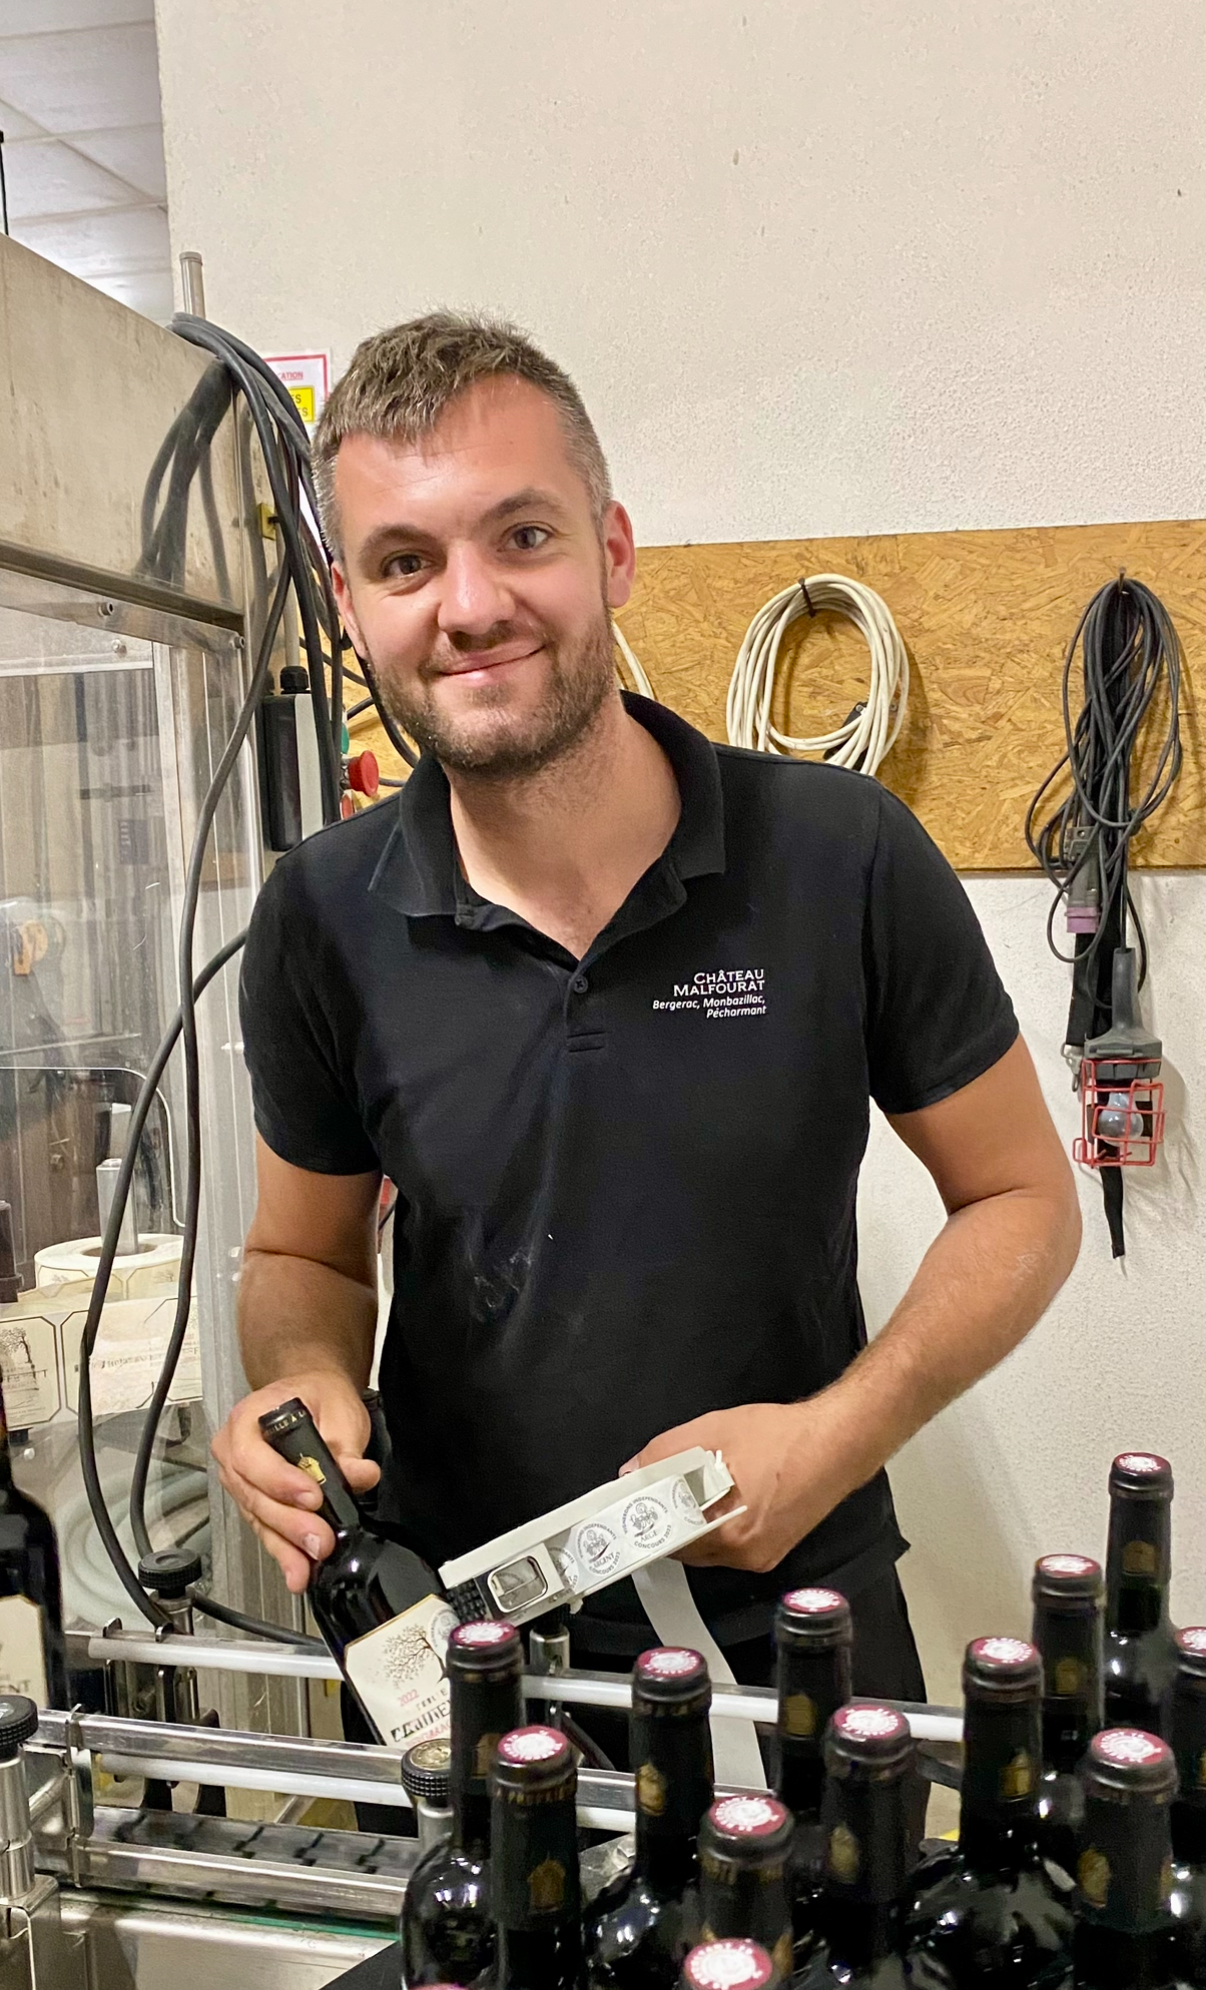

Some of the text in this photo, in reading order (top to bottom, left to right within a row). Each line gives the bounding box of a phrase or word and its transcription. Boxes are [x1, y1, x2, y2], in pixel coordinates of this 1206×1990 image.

[694, 969, 764, 984] CHÂTEAU
[674, 980, 765, 996] MALFOURAT
[653, 995, 765, 1011] Bergerac, Monbazillac,
[707, 1006, 766, 1018] Pécharmant
[633, 1538, 666, 1549] CONCOURS
